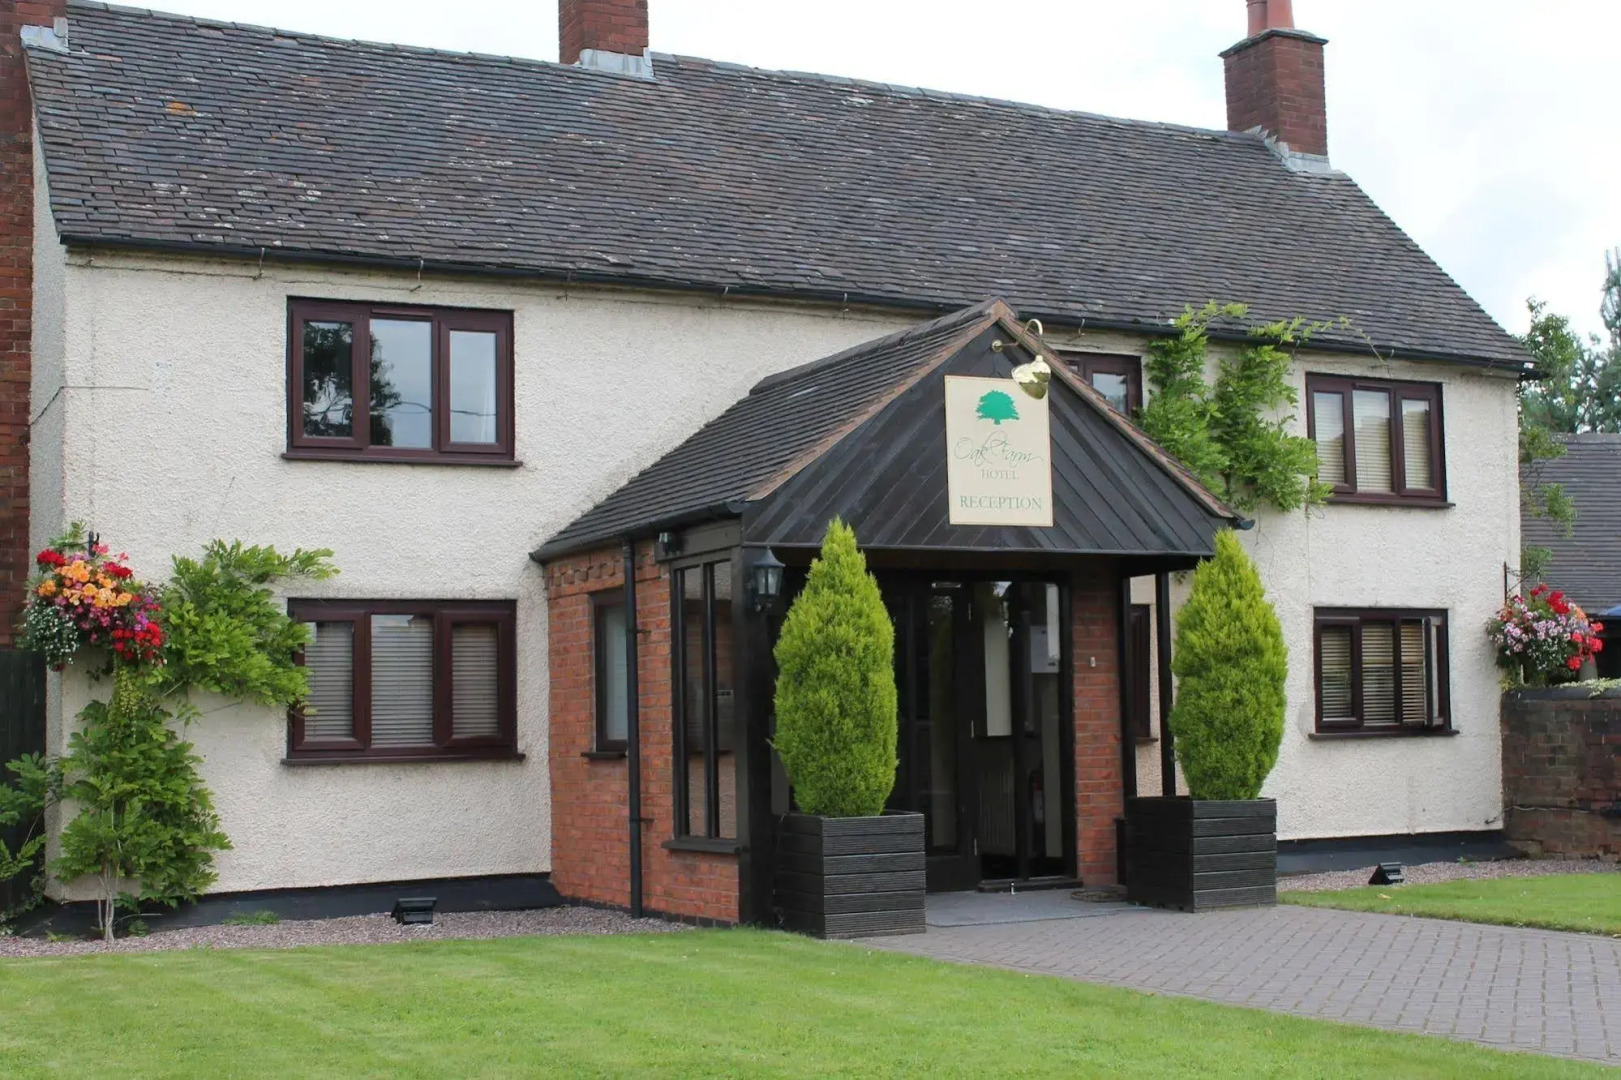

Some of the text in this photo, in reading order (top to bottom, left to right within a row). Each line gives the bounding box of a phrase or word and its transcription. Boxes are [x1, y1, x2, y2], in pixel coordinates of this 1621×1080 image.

[953, 430, 1043, 468] Oak Farm
[981, 469, 1020, 480] HOTEL
[960, 495, 1042, 510] RECEPTION
